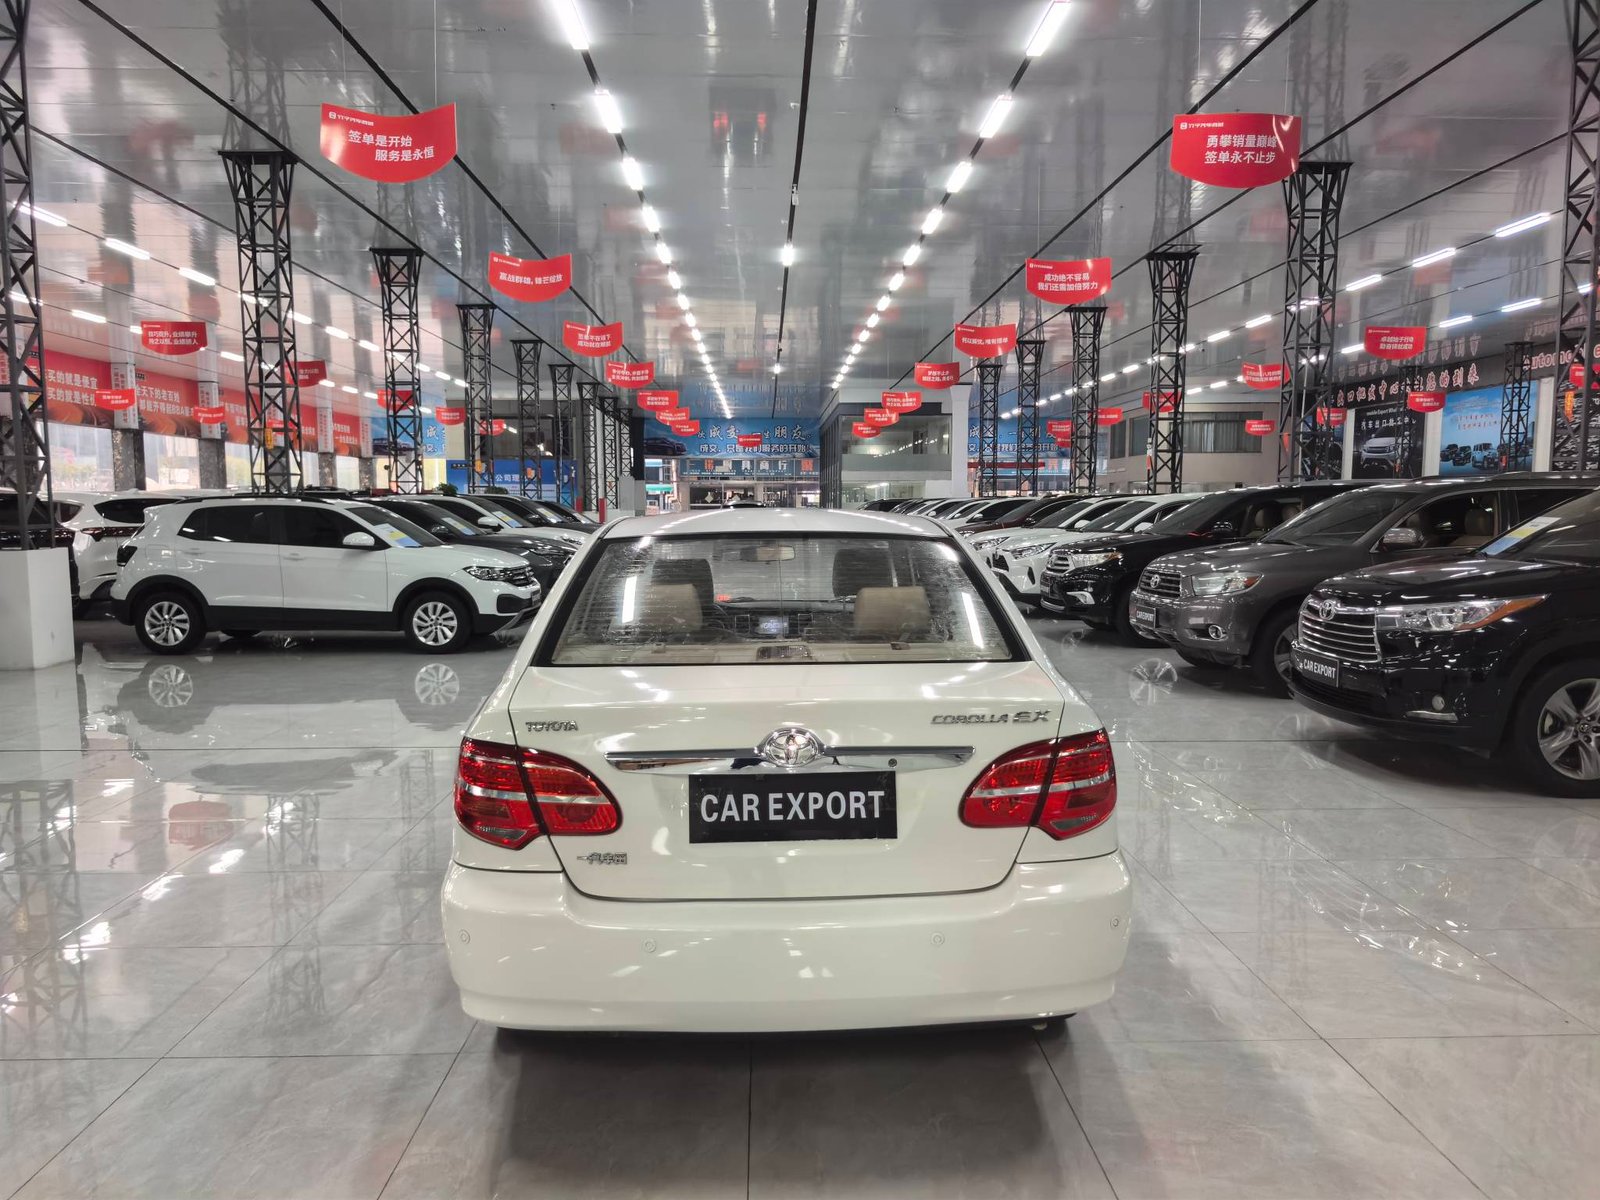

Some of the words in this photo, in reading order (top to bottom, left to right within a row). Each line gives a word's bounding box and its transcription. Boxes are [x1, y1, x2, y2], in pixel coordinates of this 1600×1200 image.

[348, 129, 413, 148] 签单是开始
[1206, 134, 1277, 149] 勇攀销量巅峰
[374, 145, 435, 162] 服务是永恒
[1204, 150, 1276, 164] 签单永不止步
[1303, 658, 1314, 672] CAR
[1313, 662, 1336, 679] EXPORT
[930, 713, 1008, 725] COROLLA
[1012, 709, 1052, 724] EX
[525, 720, 579, 732] TOYOTA
[700, 793, 760, 823] CAR
[768, 790, 886, 822] EXPORT
